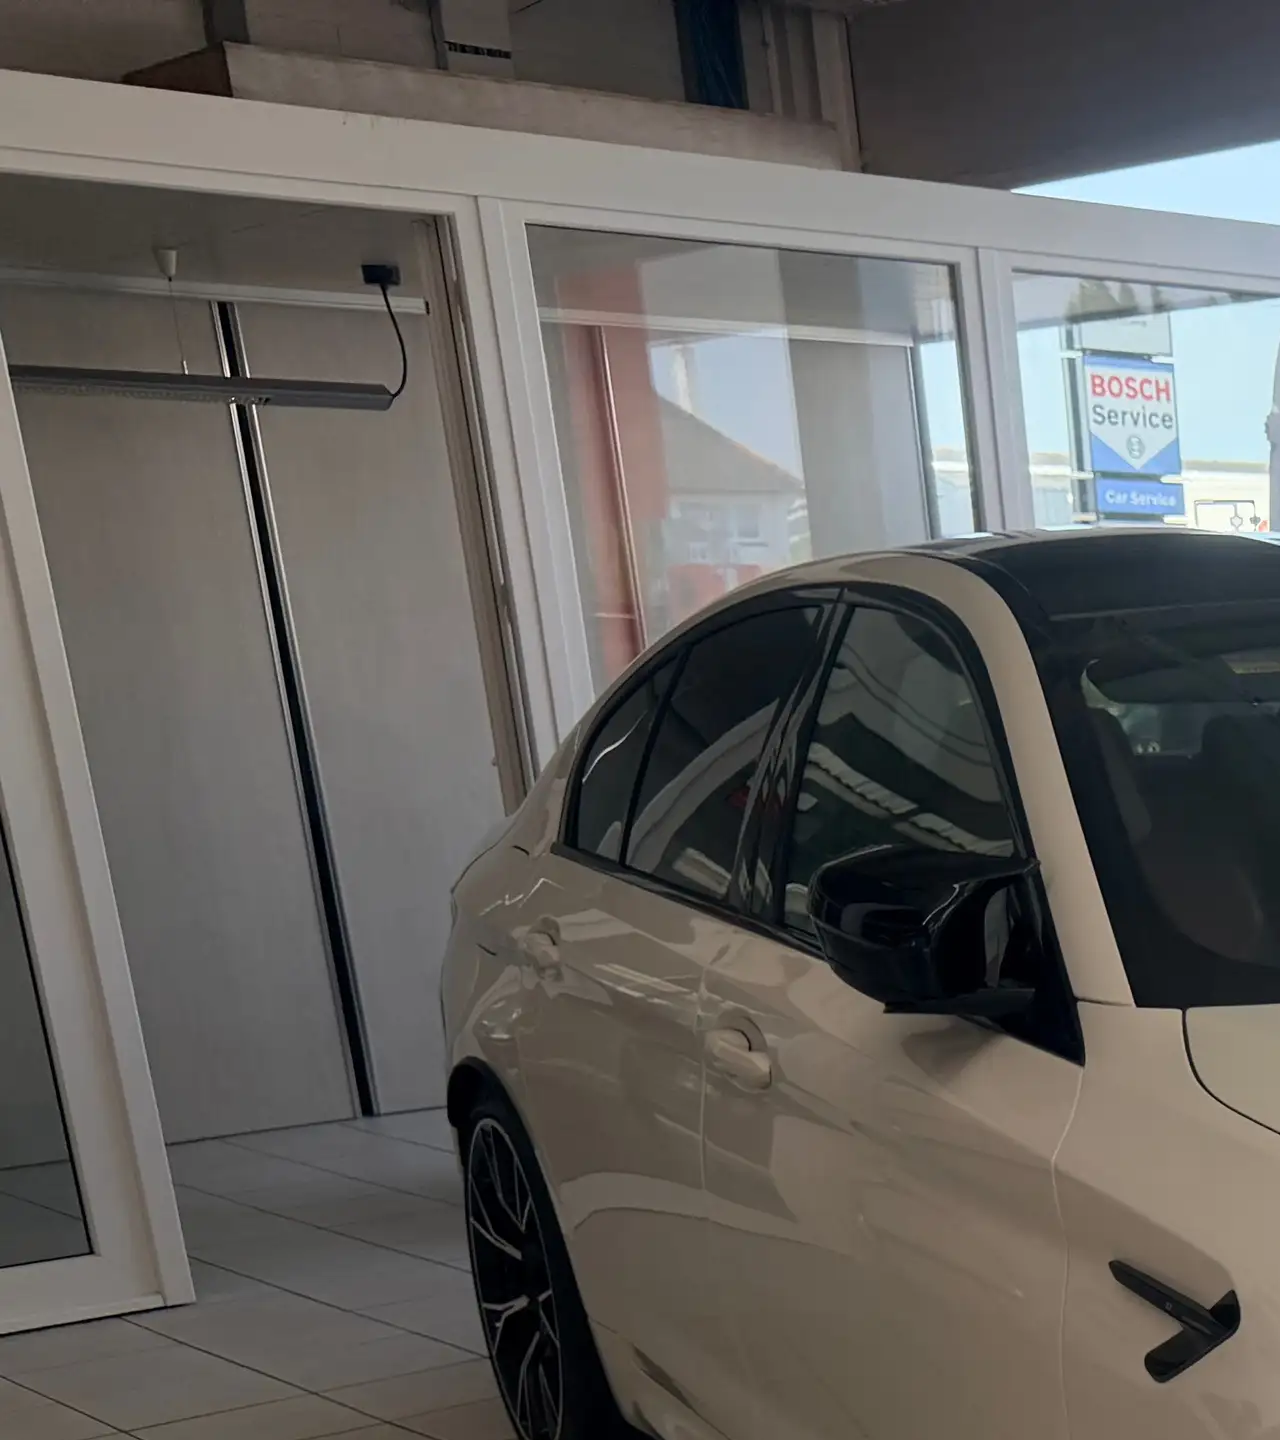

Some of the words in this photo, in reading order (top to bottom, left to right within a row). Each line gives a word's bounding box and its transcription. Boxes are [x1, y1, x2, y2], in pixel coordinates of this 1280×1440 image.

[1091, 374, 1171, 402] BOSCH
[1092, 404, 1174, 430] Service
[1105, 489, 1129, 504] Car
[1129, 490, 1177, 507] Service
